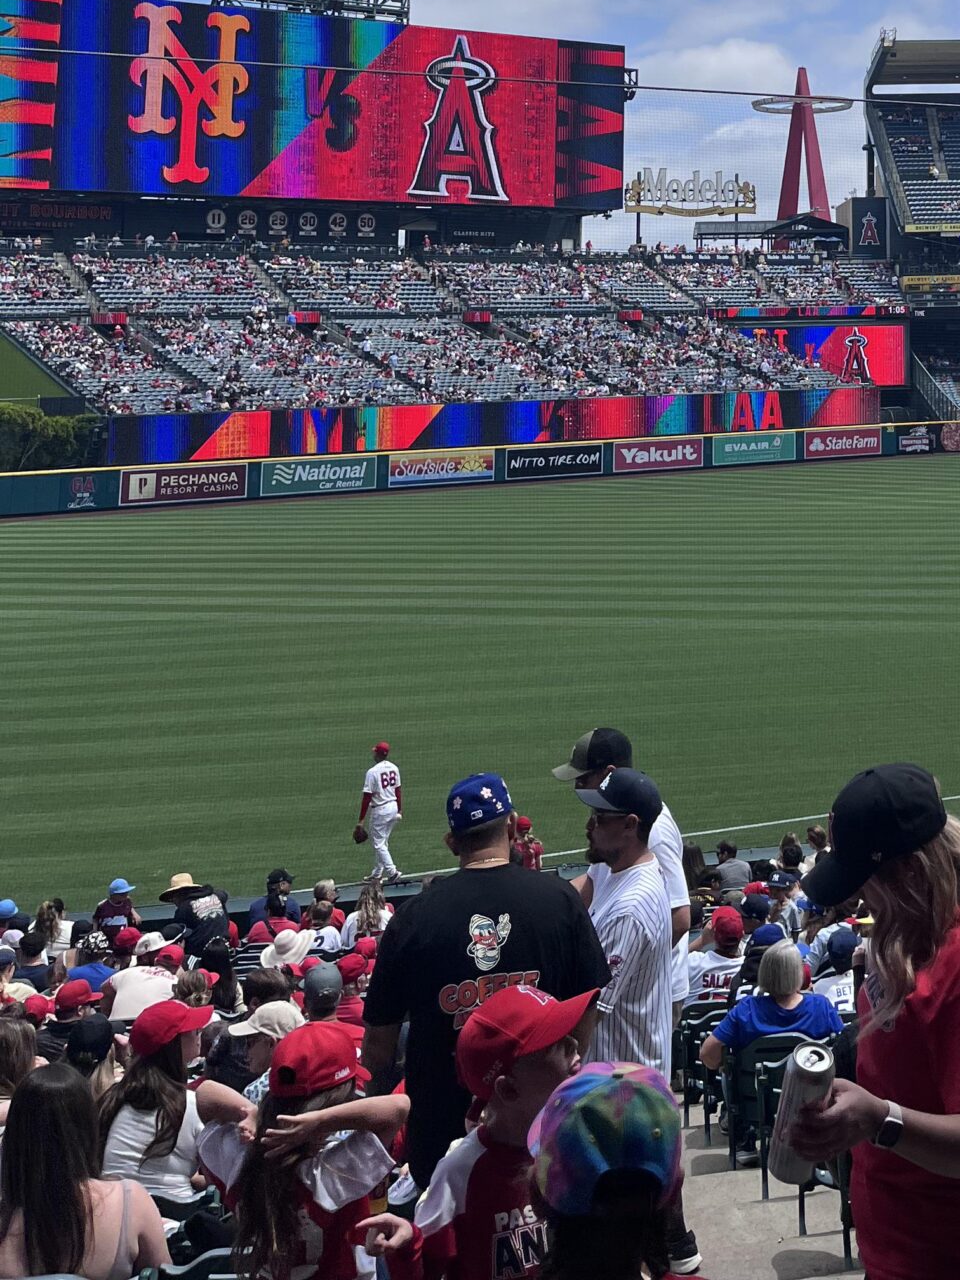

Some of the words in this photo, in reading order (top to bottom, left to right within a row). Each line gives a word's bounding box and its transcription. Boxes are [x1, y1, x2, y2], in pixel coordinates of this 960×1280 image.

[643, 167, 739, 203] Modelo
[30, 204, 112, 220] BOURBON
[888, 306, 906, 314] 1:05
[510, 456, 545, 469] NITTO
[549, 452, 600, 466] TIRE.COM
[620, 444, 698, 464] Yakult
[294, 462, 367, 481] National
[395, 457, 456, 478] Surfside
[161, 472, 238, 486] PECHANGA
[160, 486, 198, 495] RESORT
[203, 483, 239, 493] CASINO
